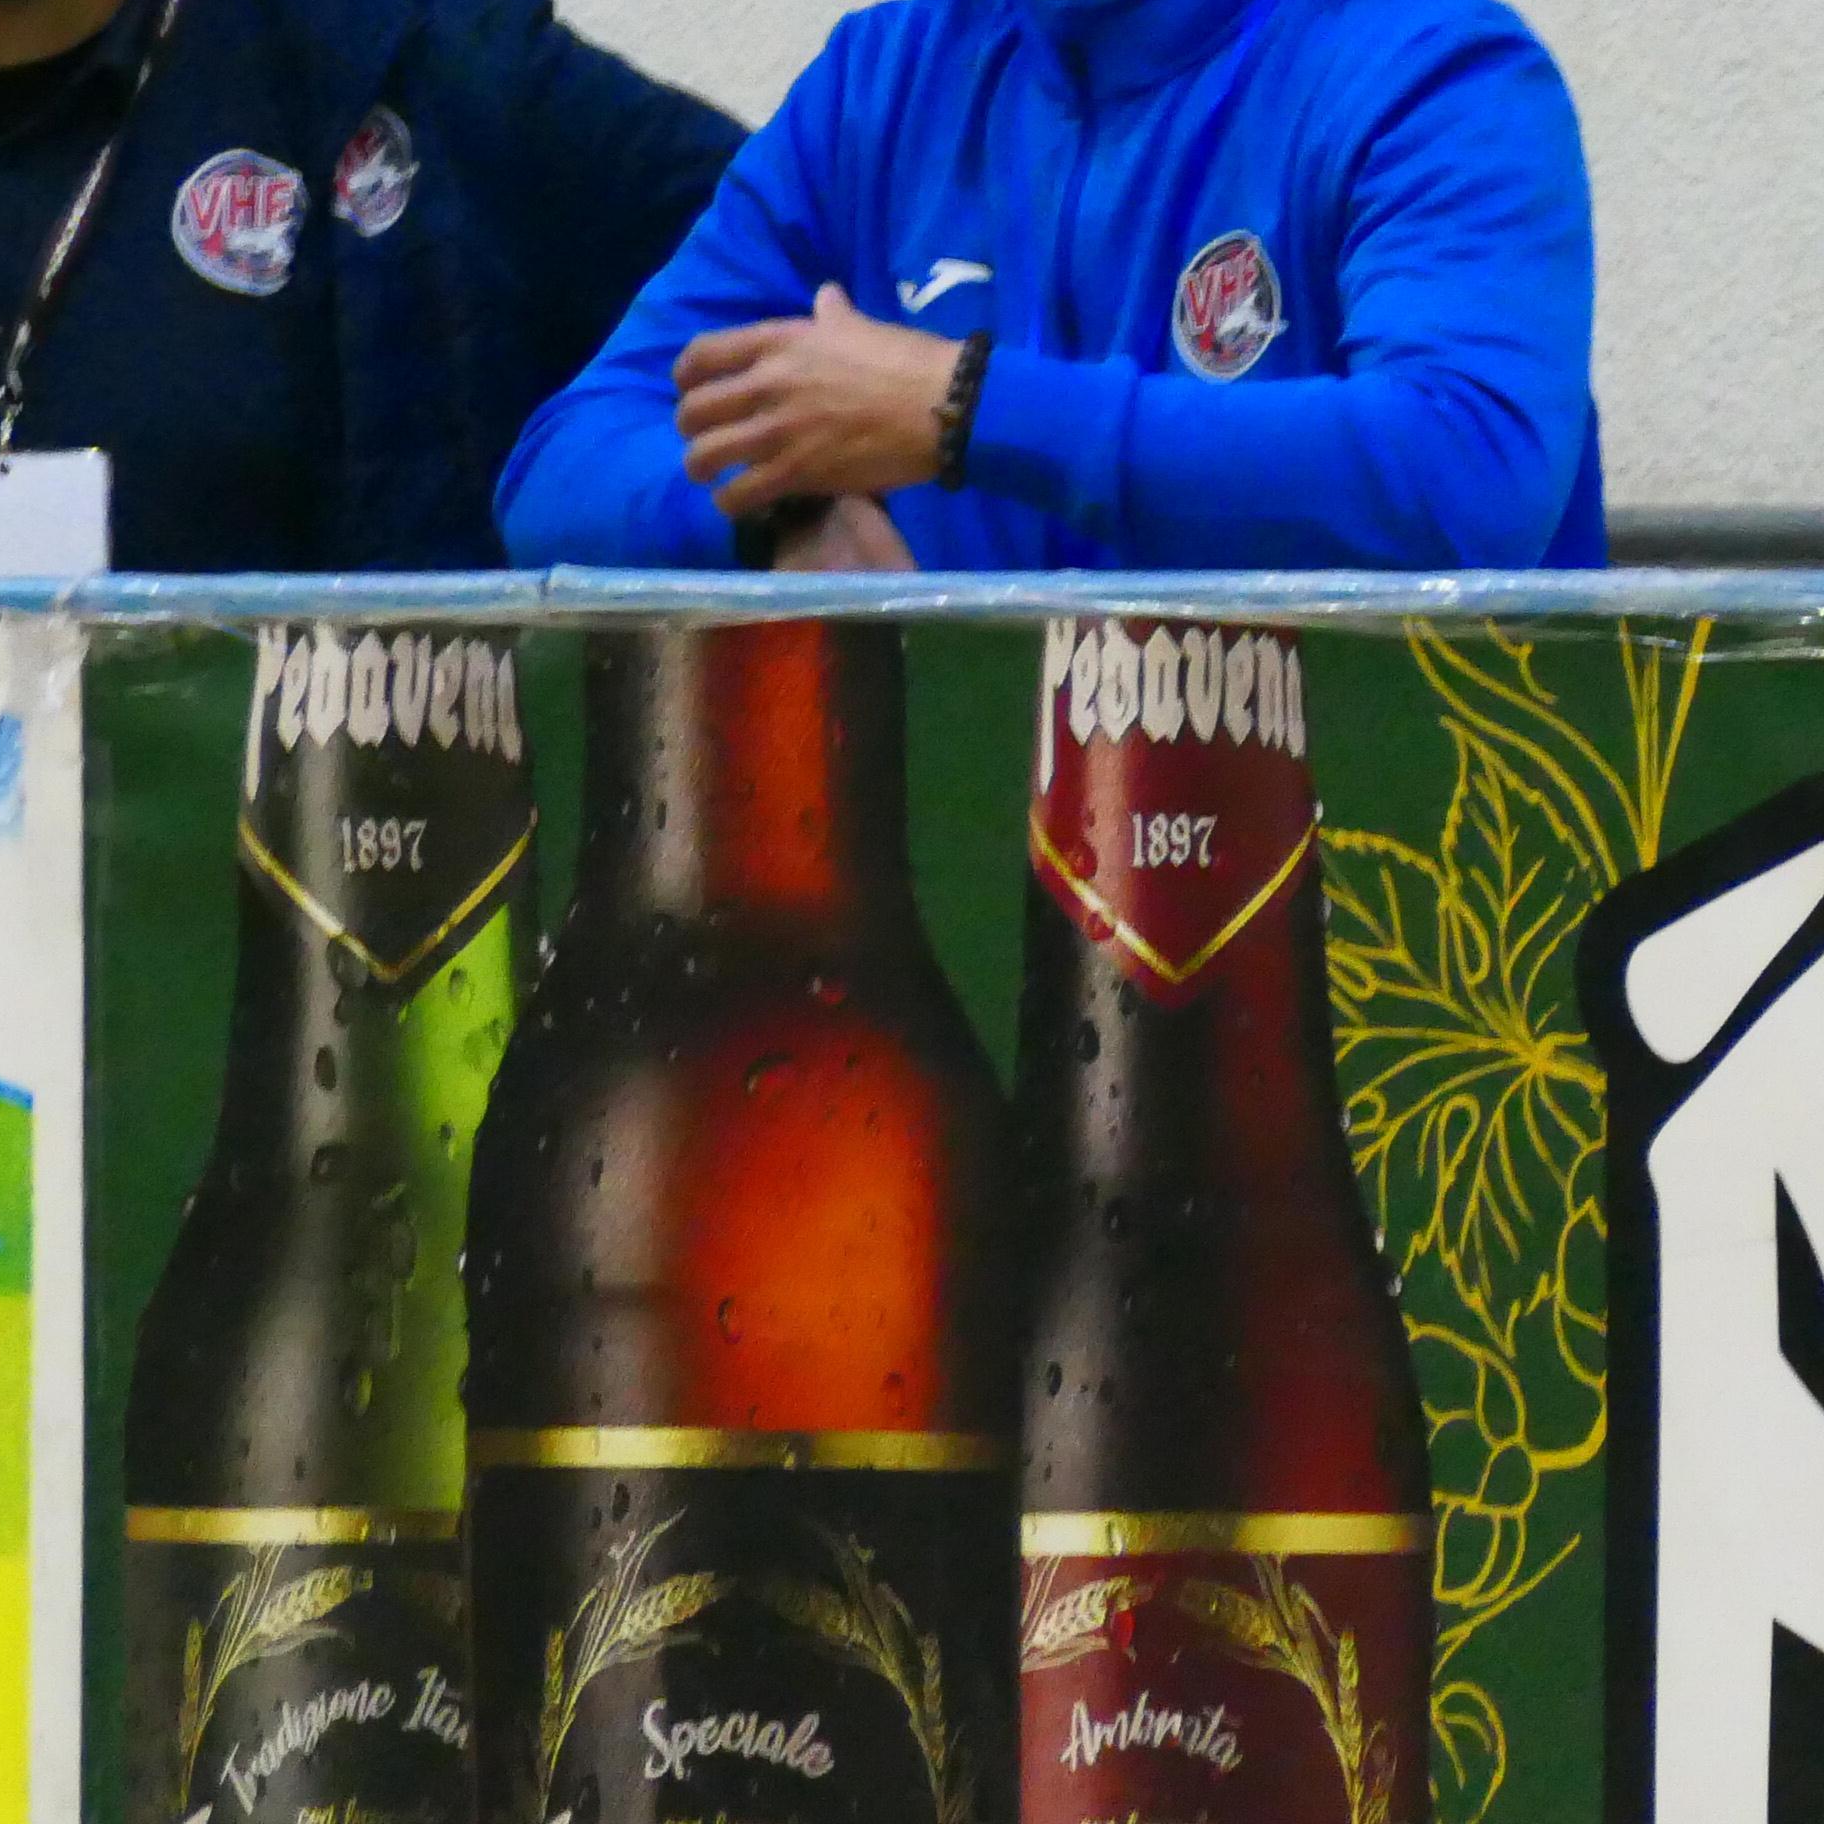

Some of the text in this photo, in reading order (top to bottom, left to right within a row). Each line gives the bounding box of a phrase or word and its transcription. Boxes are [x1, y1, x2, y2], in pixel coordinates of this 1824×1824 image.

[340, 815, 428, 873] 1897
[1129, 811, 1218, 868] 1897
[641, 1698, 835, 1779] Speciale
[1060, 1689, 1244, 1772] Ambrata
